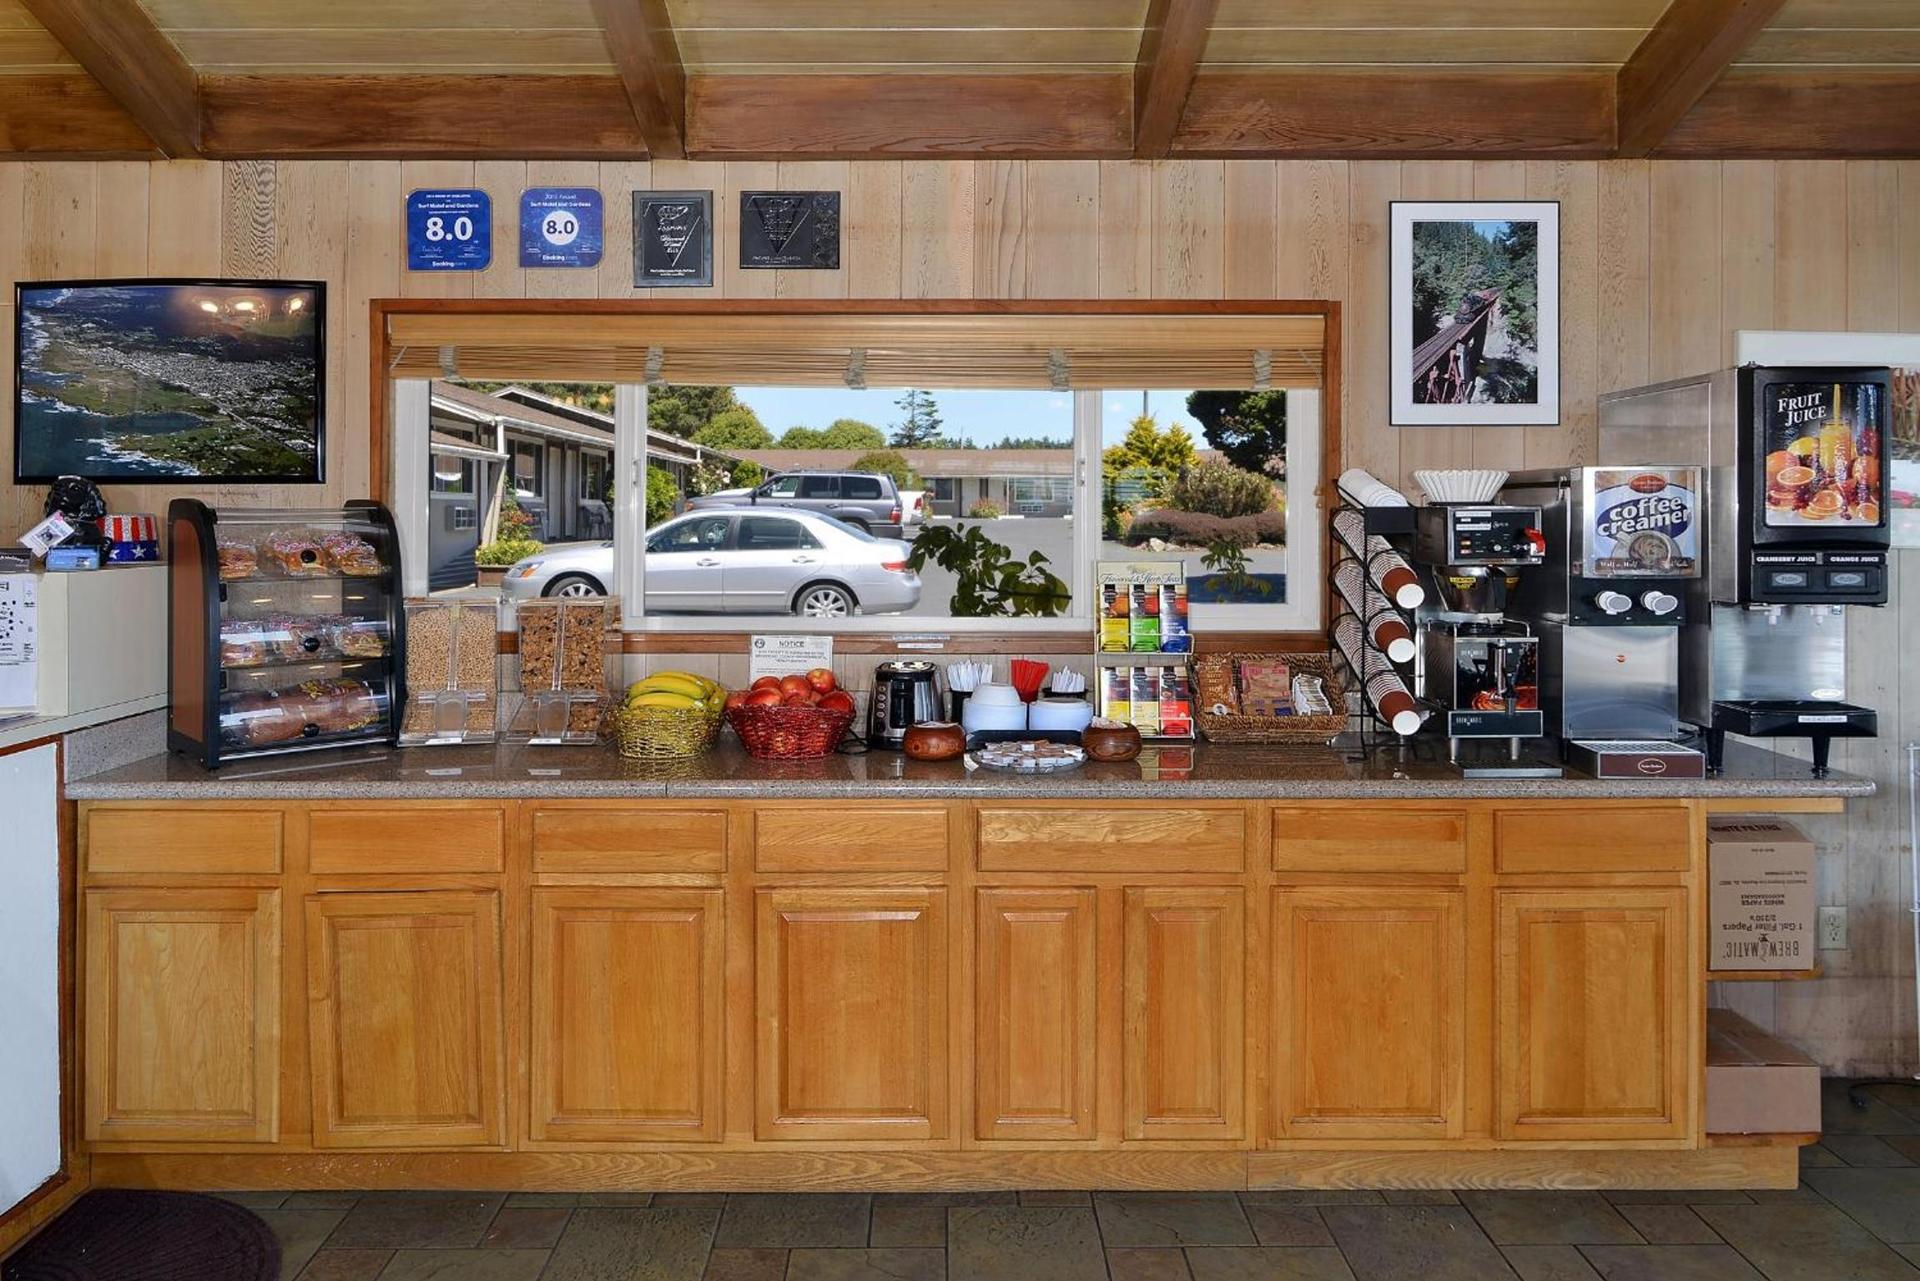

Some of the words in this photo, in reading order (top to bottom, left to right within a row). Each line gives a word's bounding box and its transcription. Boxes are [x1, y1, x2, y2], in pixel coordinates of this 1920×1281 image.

[426, 216, 473, 242] 8.0
[546, 220, 575, 234] 8.0
[1777, 392, 1822, 413] FRUIT
[1784, 405, 1827, 426] JUICE
[1610, 497, 1681, 521] coffee
[1598, 510, 1689, 535] creamer
[1722, 921, 1752, 931] Papers
[1756, 923, 1777, 931] Filter
